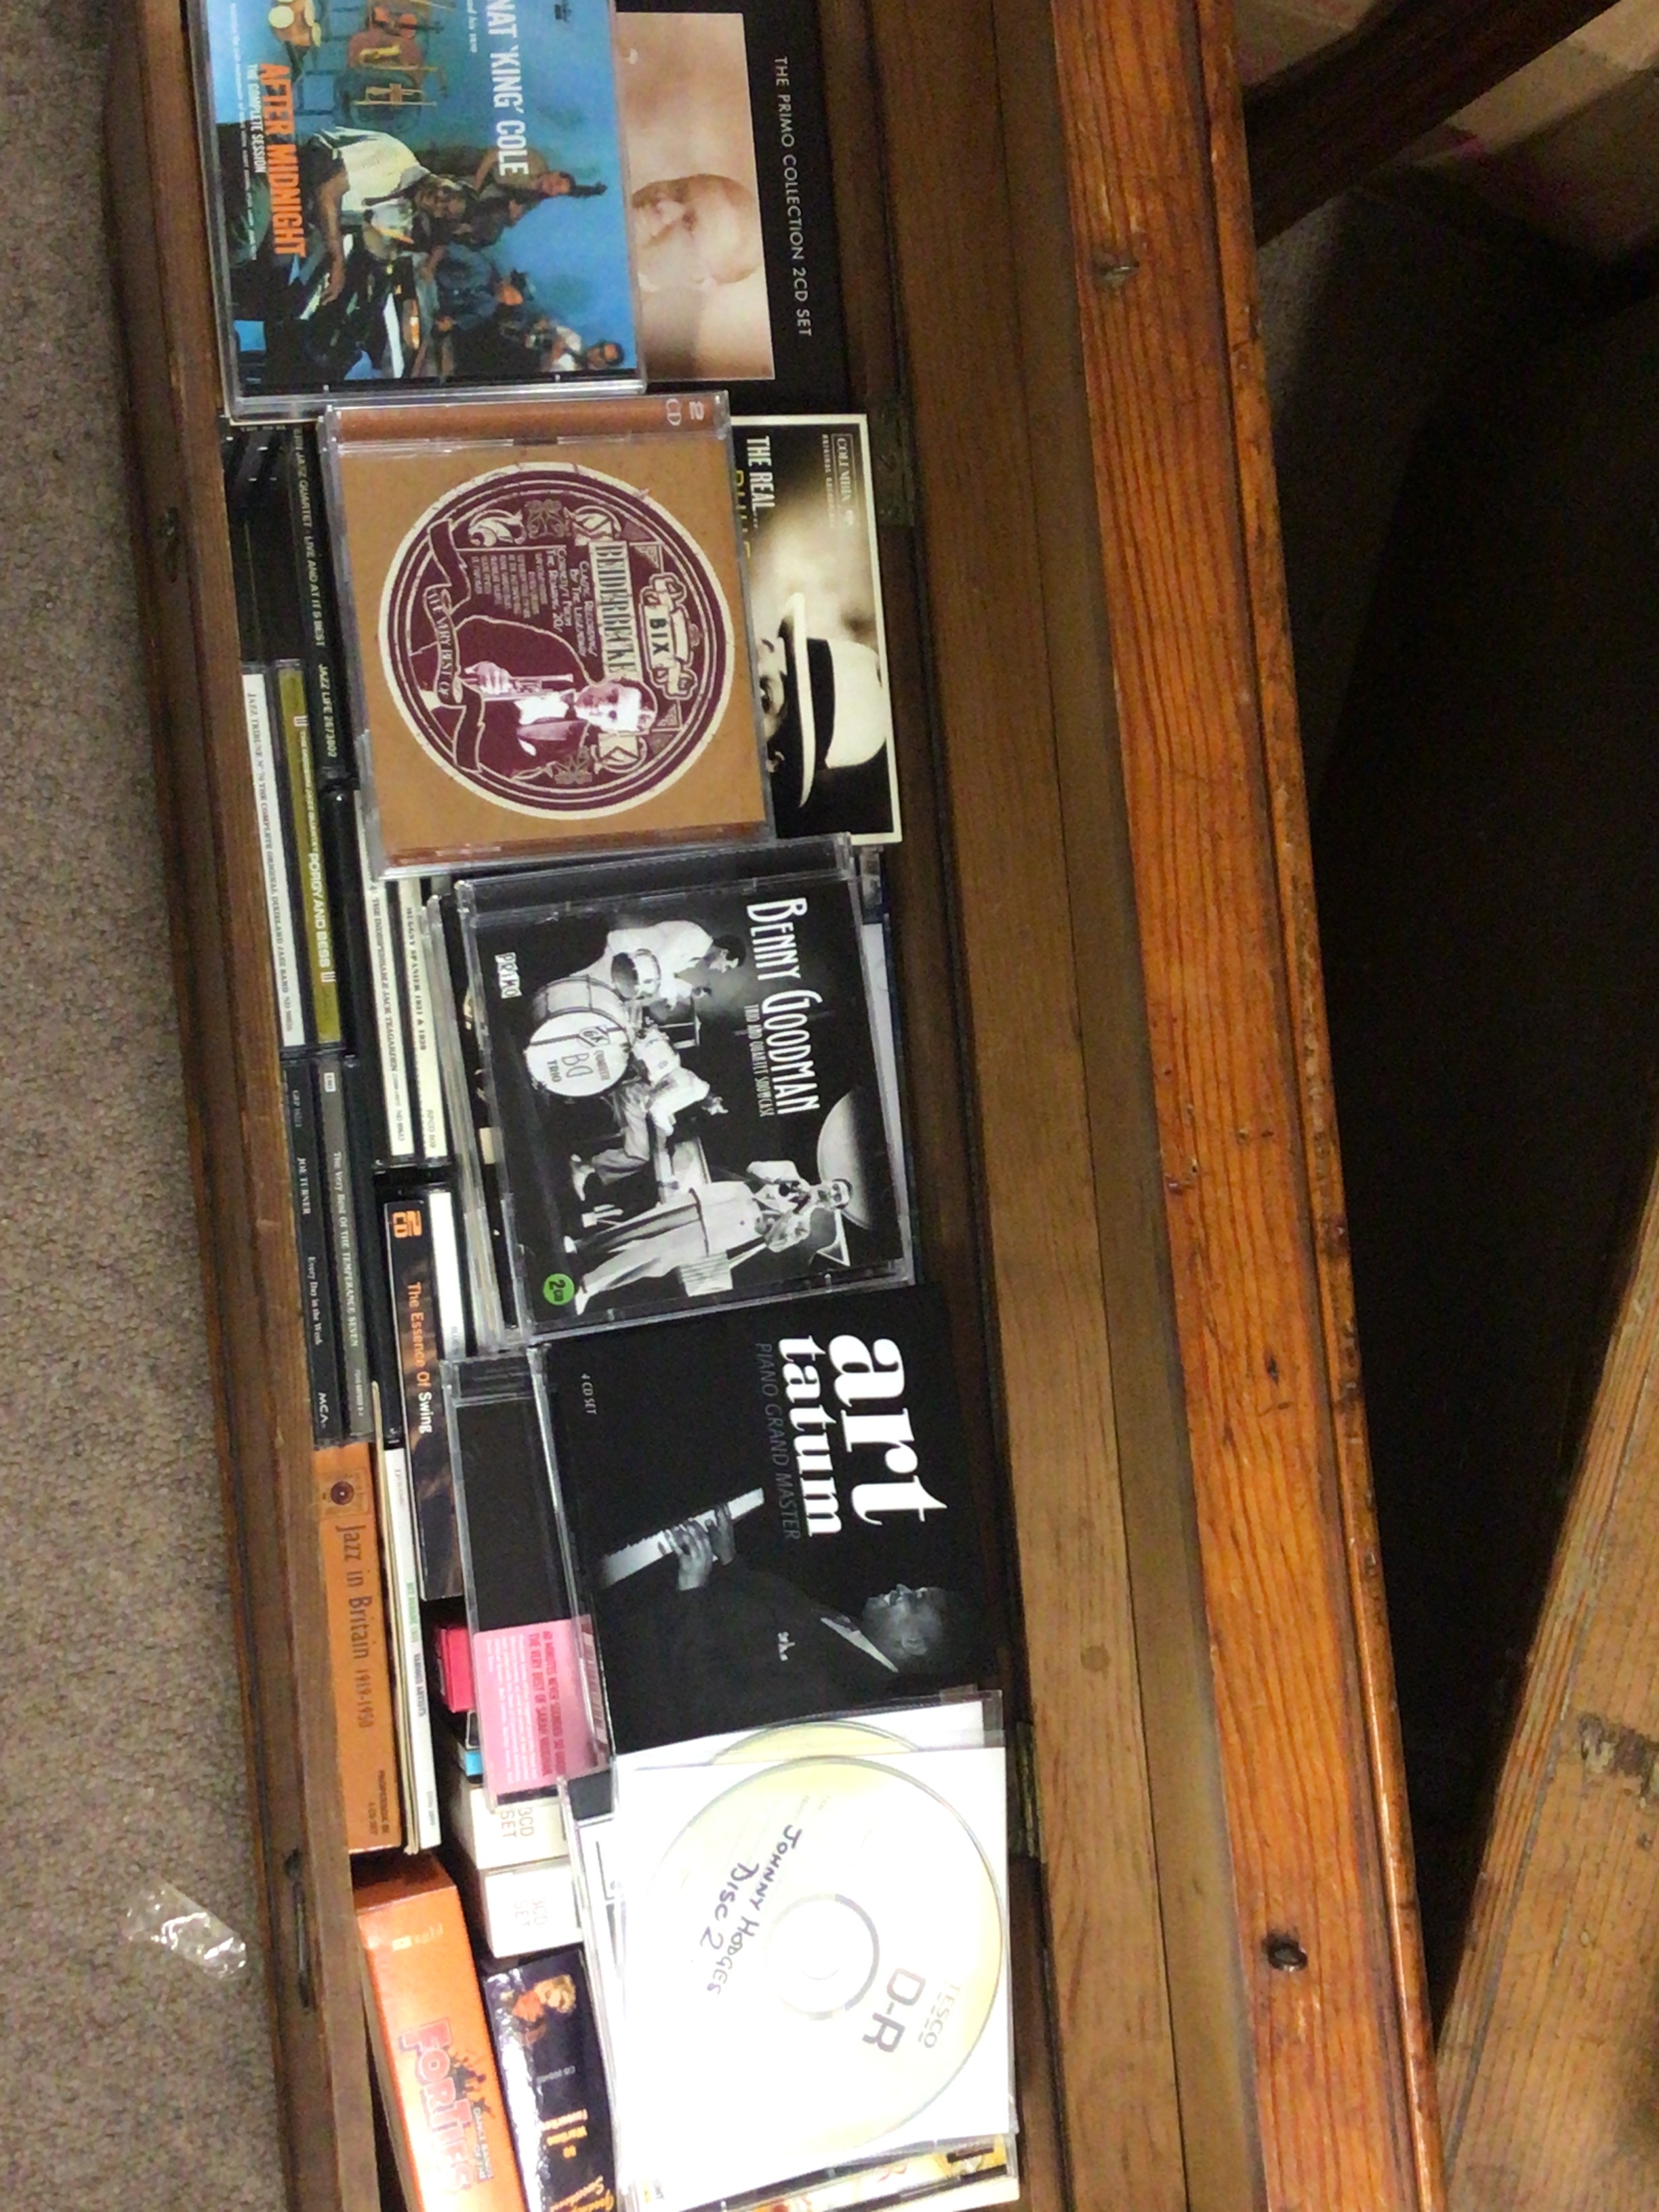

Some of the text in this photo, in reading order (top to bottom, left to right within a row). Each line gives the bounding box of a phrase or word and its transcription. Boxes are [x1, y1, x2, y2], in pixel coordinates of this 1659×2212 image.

[485, 0, 518, 38] NAT
[245, 64, 266, 173] THE COMPLETE SESSION
[260, 63, 306, 258] AFTER MIDNIGHT
[495, 120, 528, 176] COLE
[773, 57, 811, 336] THE PRIMO COLLECTION 2CD SET
[665, 398, 681, 425] CD
[745, 436, 771, 467] THE
[836, 437, 852, 502] COLUMBIA
[298, 479, 312, 527] QUARTET
[304, 535, 315, 558] LIVE
[306, 560, 318, 582] AND
[309, 584, 321, 596] AT
[594, 544, 636, 673] BEIDERBECKE
[312, 620, 325, 647] BEST
[436, 617, 451, 645] VERY
[649, 618, 668, 655] BIX
[318, 663, 329, 689] JAZZ
[441, 649, 453, 675] BEST
[247, 693, 259, 716] JAZZ
[321, 692, 332, 714] LIFE
[307, 853, 323, 898] PORGY
[313, 899, 325, 929] AND
[371, 897, 381, 916] THE
[315, 931, 329, 967] BESS
[495, 954, 520, 998] PRIMO
[381, 990, 392, 1014] JACK
[745, 897, 822, 1115] BENNY GOODMAN
[384, 1016, 397, 1071] TEAGARDEN
[546, 1059, 561, 1082] TRIO
[743, 1004, 775, 1117] TRIO AND QUARTET SHOWCASE
[296, 1157, 310, 1214] JOE TURNER
[333, 1171, 343, 1191] Very
[392, 1212, 408, 1239] CD
[306, 1256, 316, 1279] Every
[342, 1252, 356, 1313] TEMPERANCE
[347, 1316, 358, 1347] SEVEN
[407, 1282, 433, 1433] The Essence Of Swing
[581, 1382, 593, 1396] CD
[317, 1393, 328, 1423] MCA
[583, 1398, 596, 1415] SET
[755, 1343, 800, 1540] PIANO GRAND MASTER
[777, 1335, 842, 1537] tatum
[828, 1335, 947, 1525] art
[334, 1525, 366, 1561] Jazz
[346, 1570, 370, 1587] in
[348, 1595, 377, 1659] Britain
[499, 1810, 516, 1838] SET
[517, 1807, 533, 1837] 3CD
[706, 1824, 802, 1995] JOHNNY HODGES
[699, 1926, 723, 1950] 2
[922, 1983, 961, 2049] TESCO
[398, 2020, 472, 2194] FORTIES
